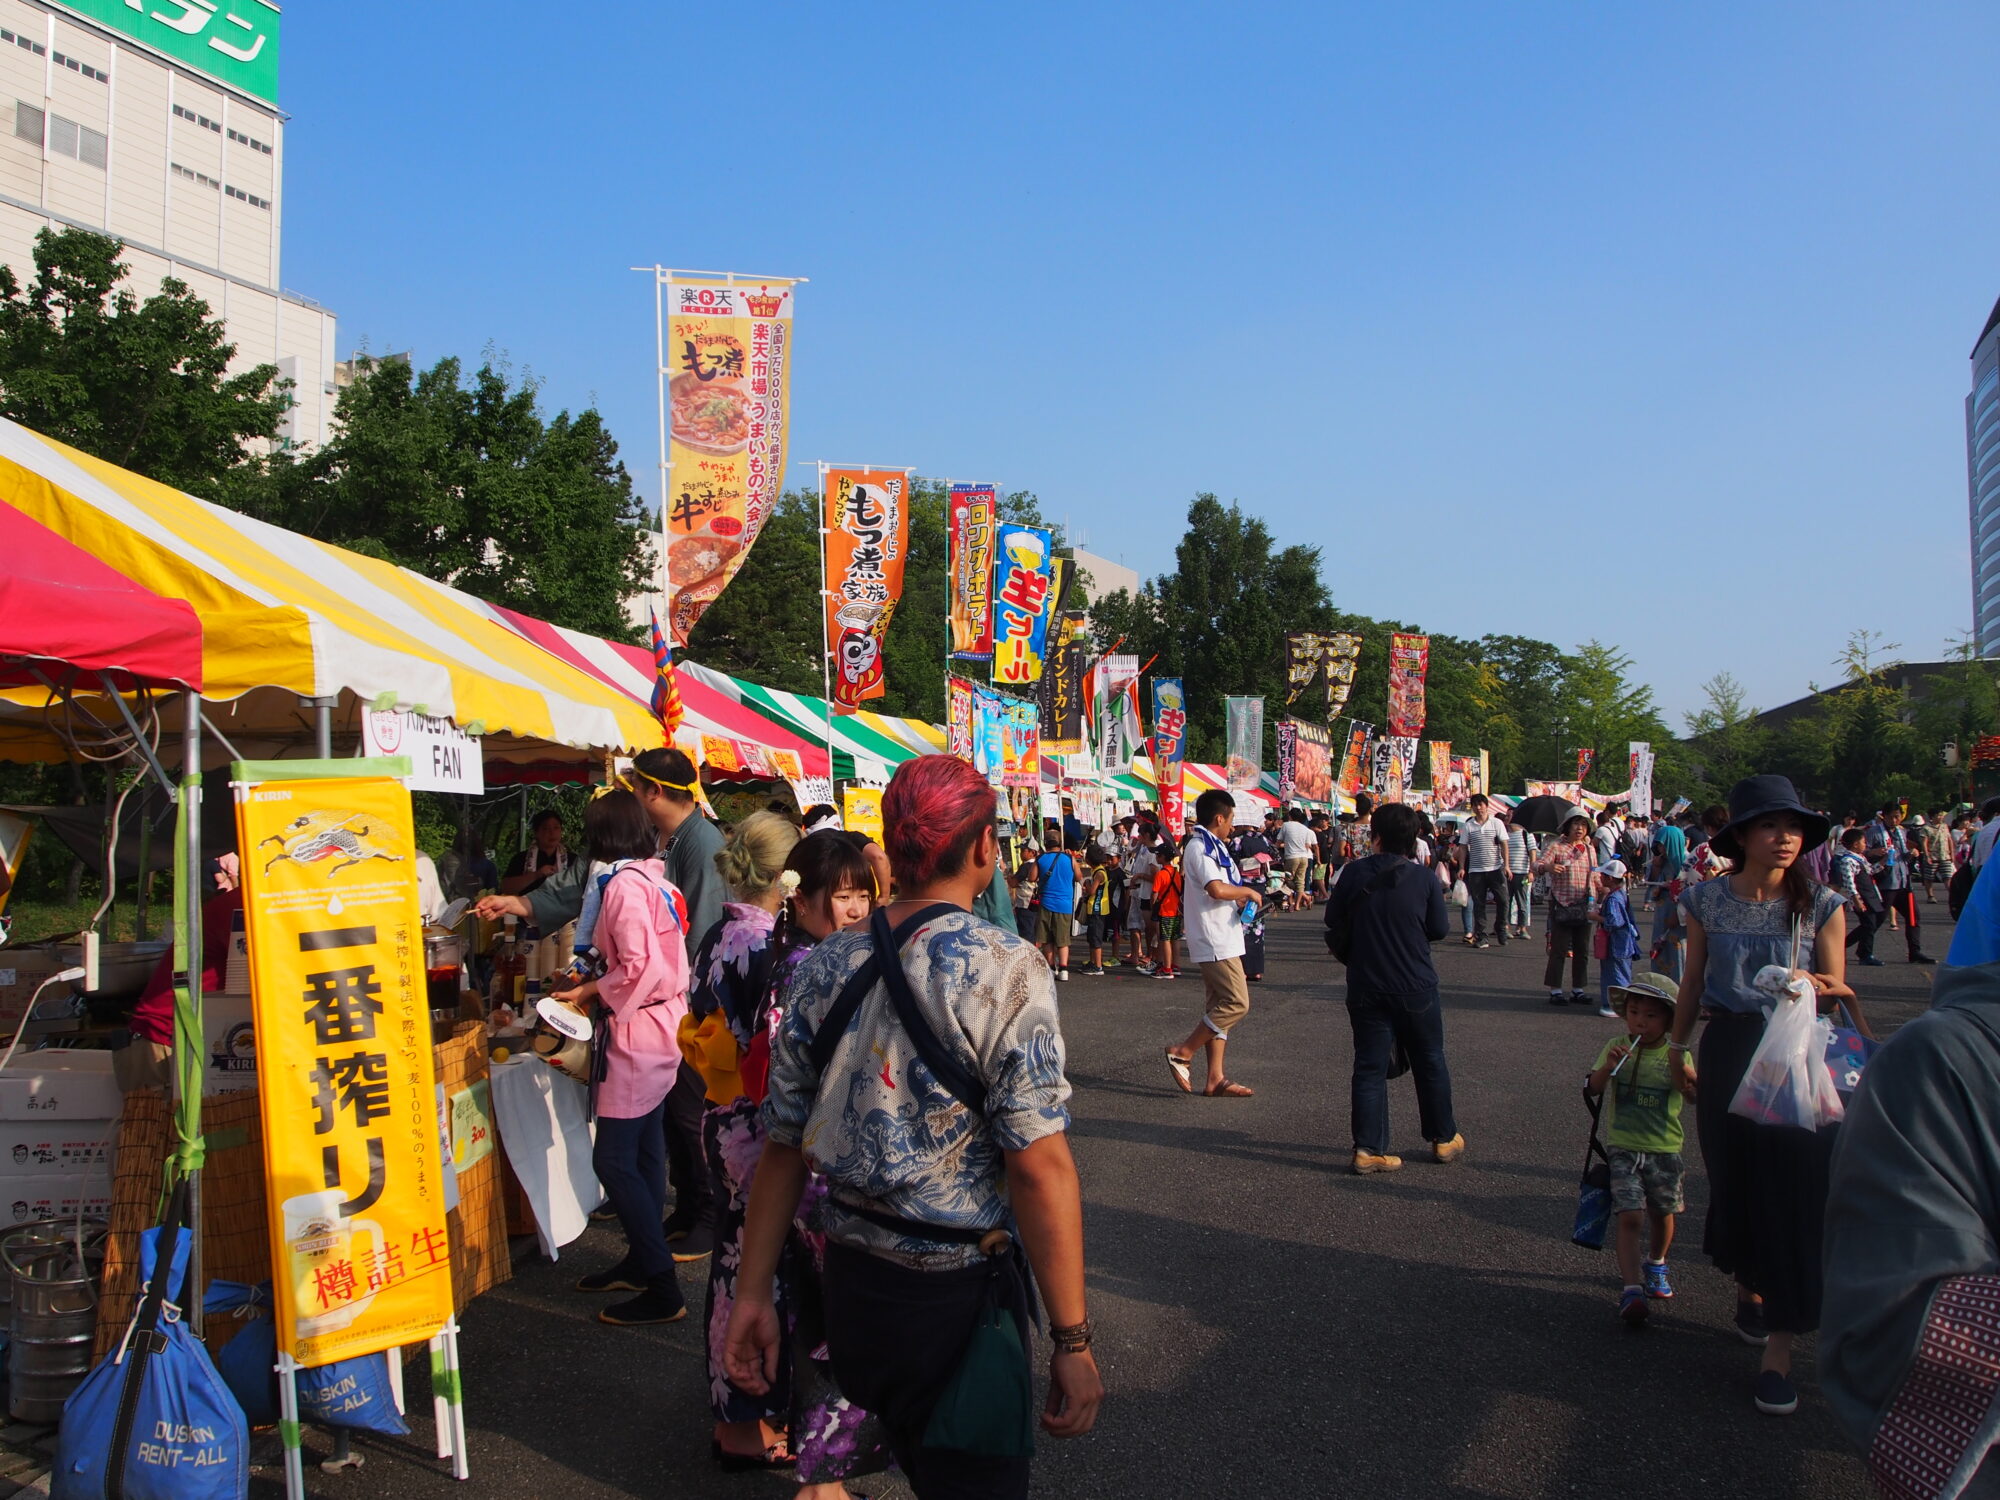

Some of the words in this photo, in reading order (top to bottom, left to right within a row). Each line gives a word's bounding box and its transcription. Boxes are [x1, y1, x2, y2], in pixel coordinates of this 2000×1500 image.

[125, 0, 266, 62] ラン
[682, 306, 732, 314] ICHIBA
[681, 340, 745, 382] もつ煮
[671, 489, 722, 531] 牛すじ
[886, 479, 902, 560] だるまおやじの
[846, 485, 885, 579] もつ煮
[841, 580, 888, 602] 家族
[967, 503, 989, 641] ロングポテト
[1002, 568, 1048, 681] 生ビール
[1053, 648, 1070, 738] インドカレー
[432, 745, 462, 780] FAN
[1156, 708, 1186, 784] 生ビール
[254, 791, 293, 802] KIRIN
[299, 925, 391, 1219] 一番搾り
[27, 1096, 59, 1111] 高崎
[471, 1125, 486, 1144] 300
[312, 1227, 450, 1309] 樽詰生
[300, 1375, 357, 1404] DUSKIN
[154, 1420, 216, 1443] DUSKIN
[137, 1441, 228, 1468] RENT-ALL
